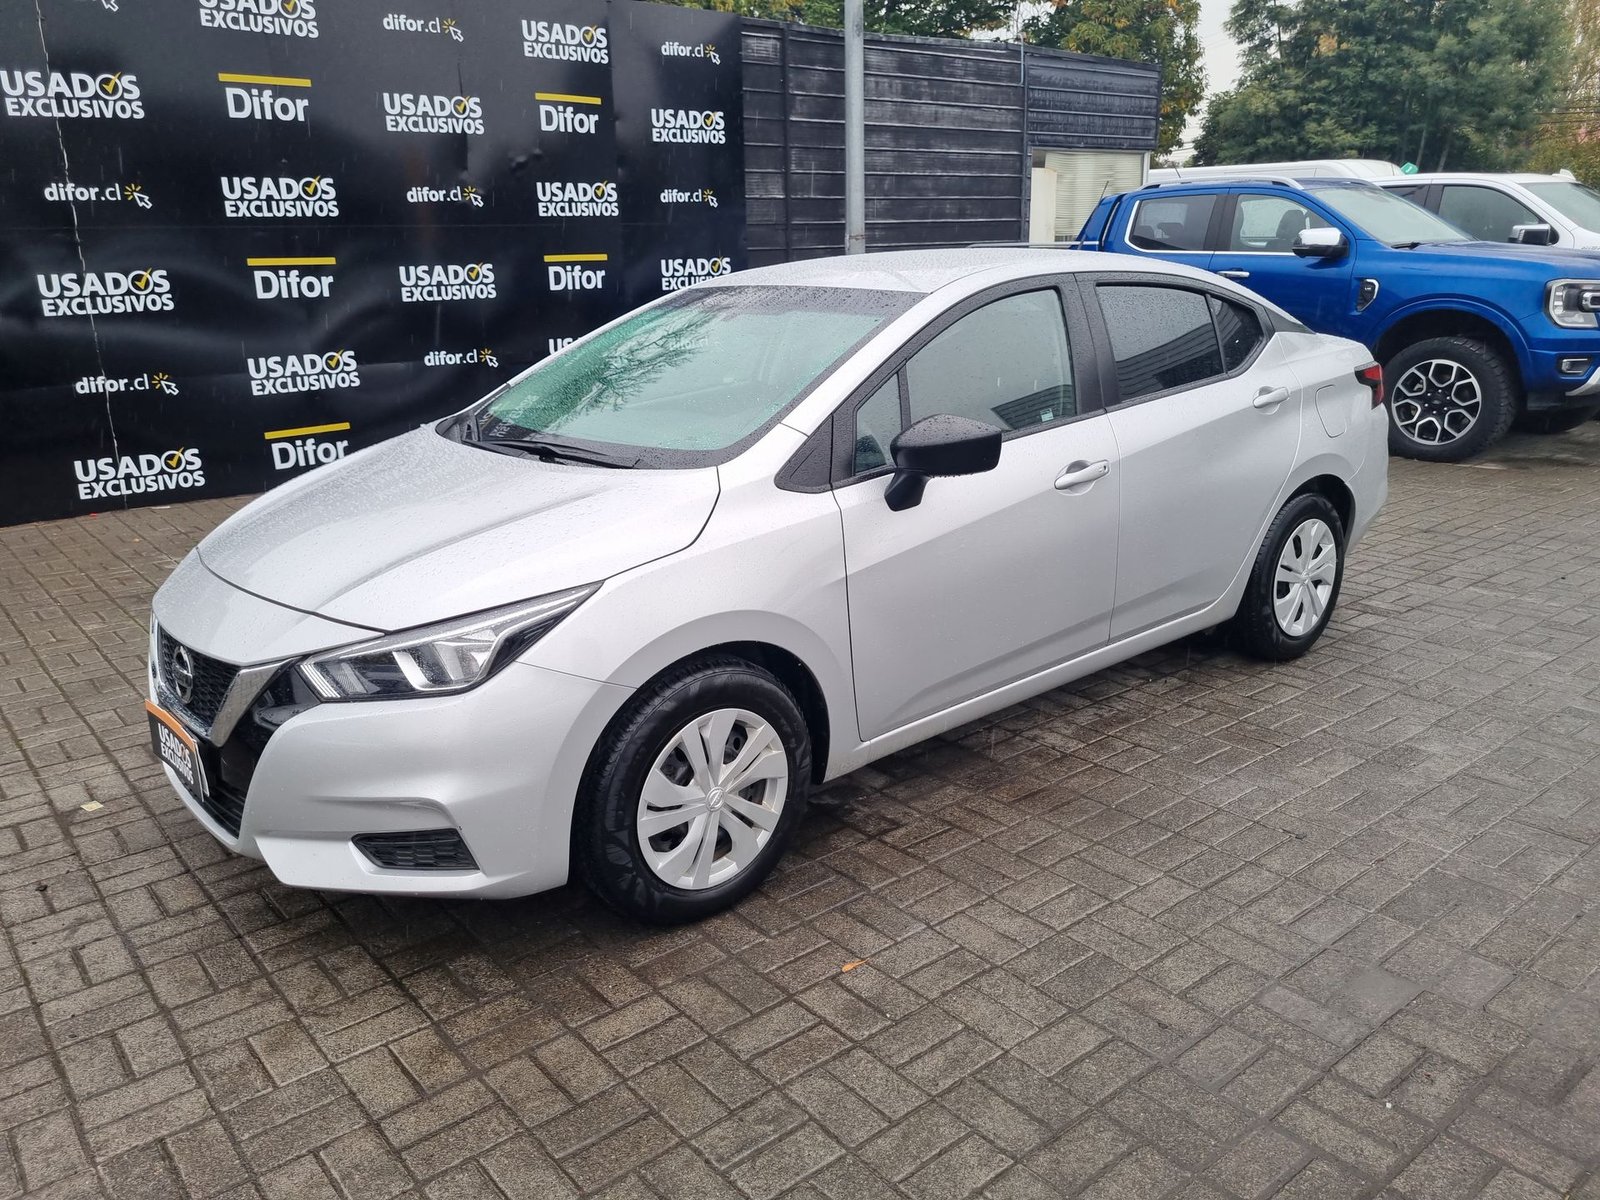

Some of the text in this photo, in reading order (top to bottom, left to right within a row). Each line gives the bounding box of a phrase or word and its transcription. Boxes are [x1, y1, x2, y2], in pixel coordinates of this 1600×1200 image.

[199, 8, 319, 38] EXCLUSIVOS
[383, 14, 441, 33] difor.cl
[521, 19, 608, 48] USADOS
[523, 42, 610, 64] EXCLUSIVOS
[661, 42, 704, 58] difor.cl
[0, 71, 141, 100] USADOS
[6, 98, 145, 119] EXCLUSIVOS
[225, 87, 309, 122] Difor
[383, 93, 482, 119] USADOS
[385, 115, 485, 135] EXCLUSIVOS
[539, 104, 599, 134] Difor
[651, 109, 725, 130] USADOS
[652, 129, 726, 144] EXCLUSIVOS
[44, 183, 121, 201] difor.cl
[221, 176, 336, 201] USADOS
[406, 186, 462, 203] difor.cl
[536, 181, 617, 202] USADOS
[660, 189, 702, 203] difor.cl
[224, 200, 339, 218] EXCLUSIVOS
[538, 201, 619, 217] EXCLUSIVOS
[399, 263, 494, 287] USADOS
[547, 265, 605, 291] Difor
[660, 257, 731, 277] USADOS
[37, 269, 170, 298] USADOS
[253, 270, 334, 299] Difor
[401, 284, 497, 302] EXCLUSIVOS
[661, 275, 716, 291] EXCLU
[42, 293, 174, 317] EXCLUSIVOS
[247, 350, 357, 379] USADOS
[424, 349, 477, 367] difor.cl
[75, 374, 149, 394] difor.cl
[251, 371, 361, 396] EXCLUSIVOS
[74, 448, 202, 482] USADOS
[271, 438, 349, 470] Difor
[78, 471, 206, 500] EXCLUSIVOS
[158, 722, 192, 769] USADOS
[160, 741, 194, 785] EXCLUSIVOS
